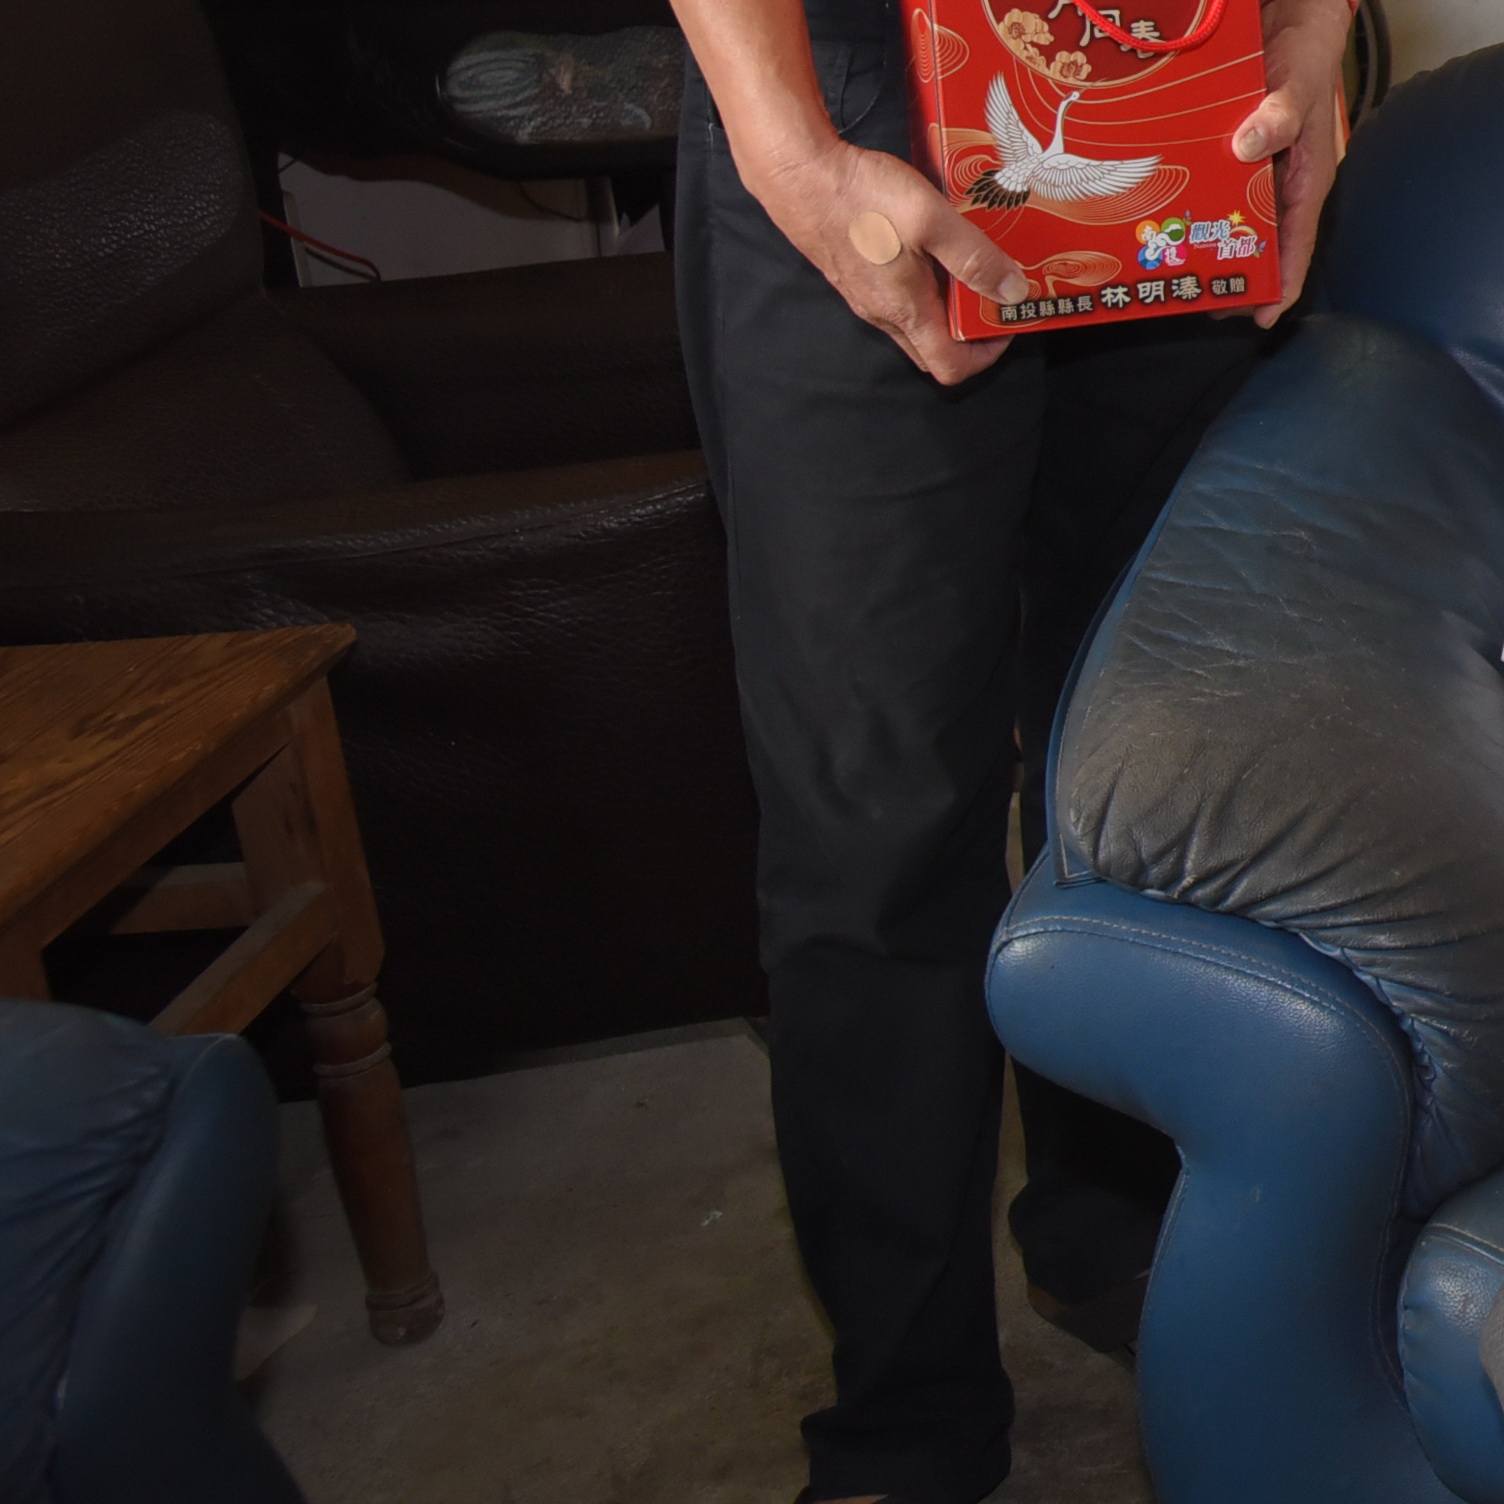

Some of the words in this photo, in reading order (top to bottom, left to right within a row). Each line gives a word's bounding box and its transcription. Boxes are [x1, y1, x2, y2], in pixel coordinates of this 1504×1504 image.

[1001, 295, 1094, 323] 南投縣縣長
[1100, 275, 1202, 309] 林明溱
[1211, 276, 1246, 296] 敬贈
